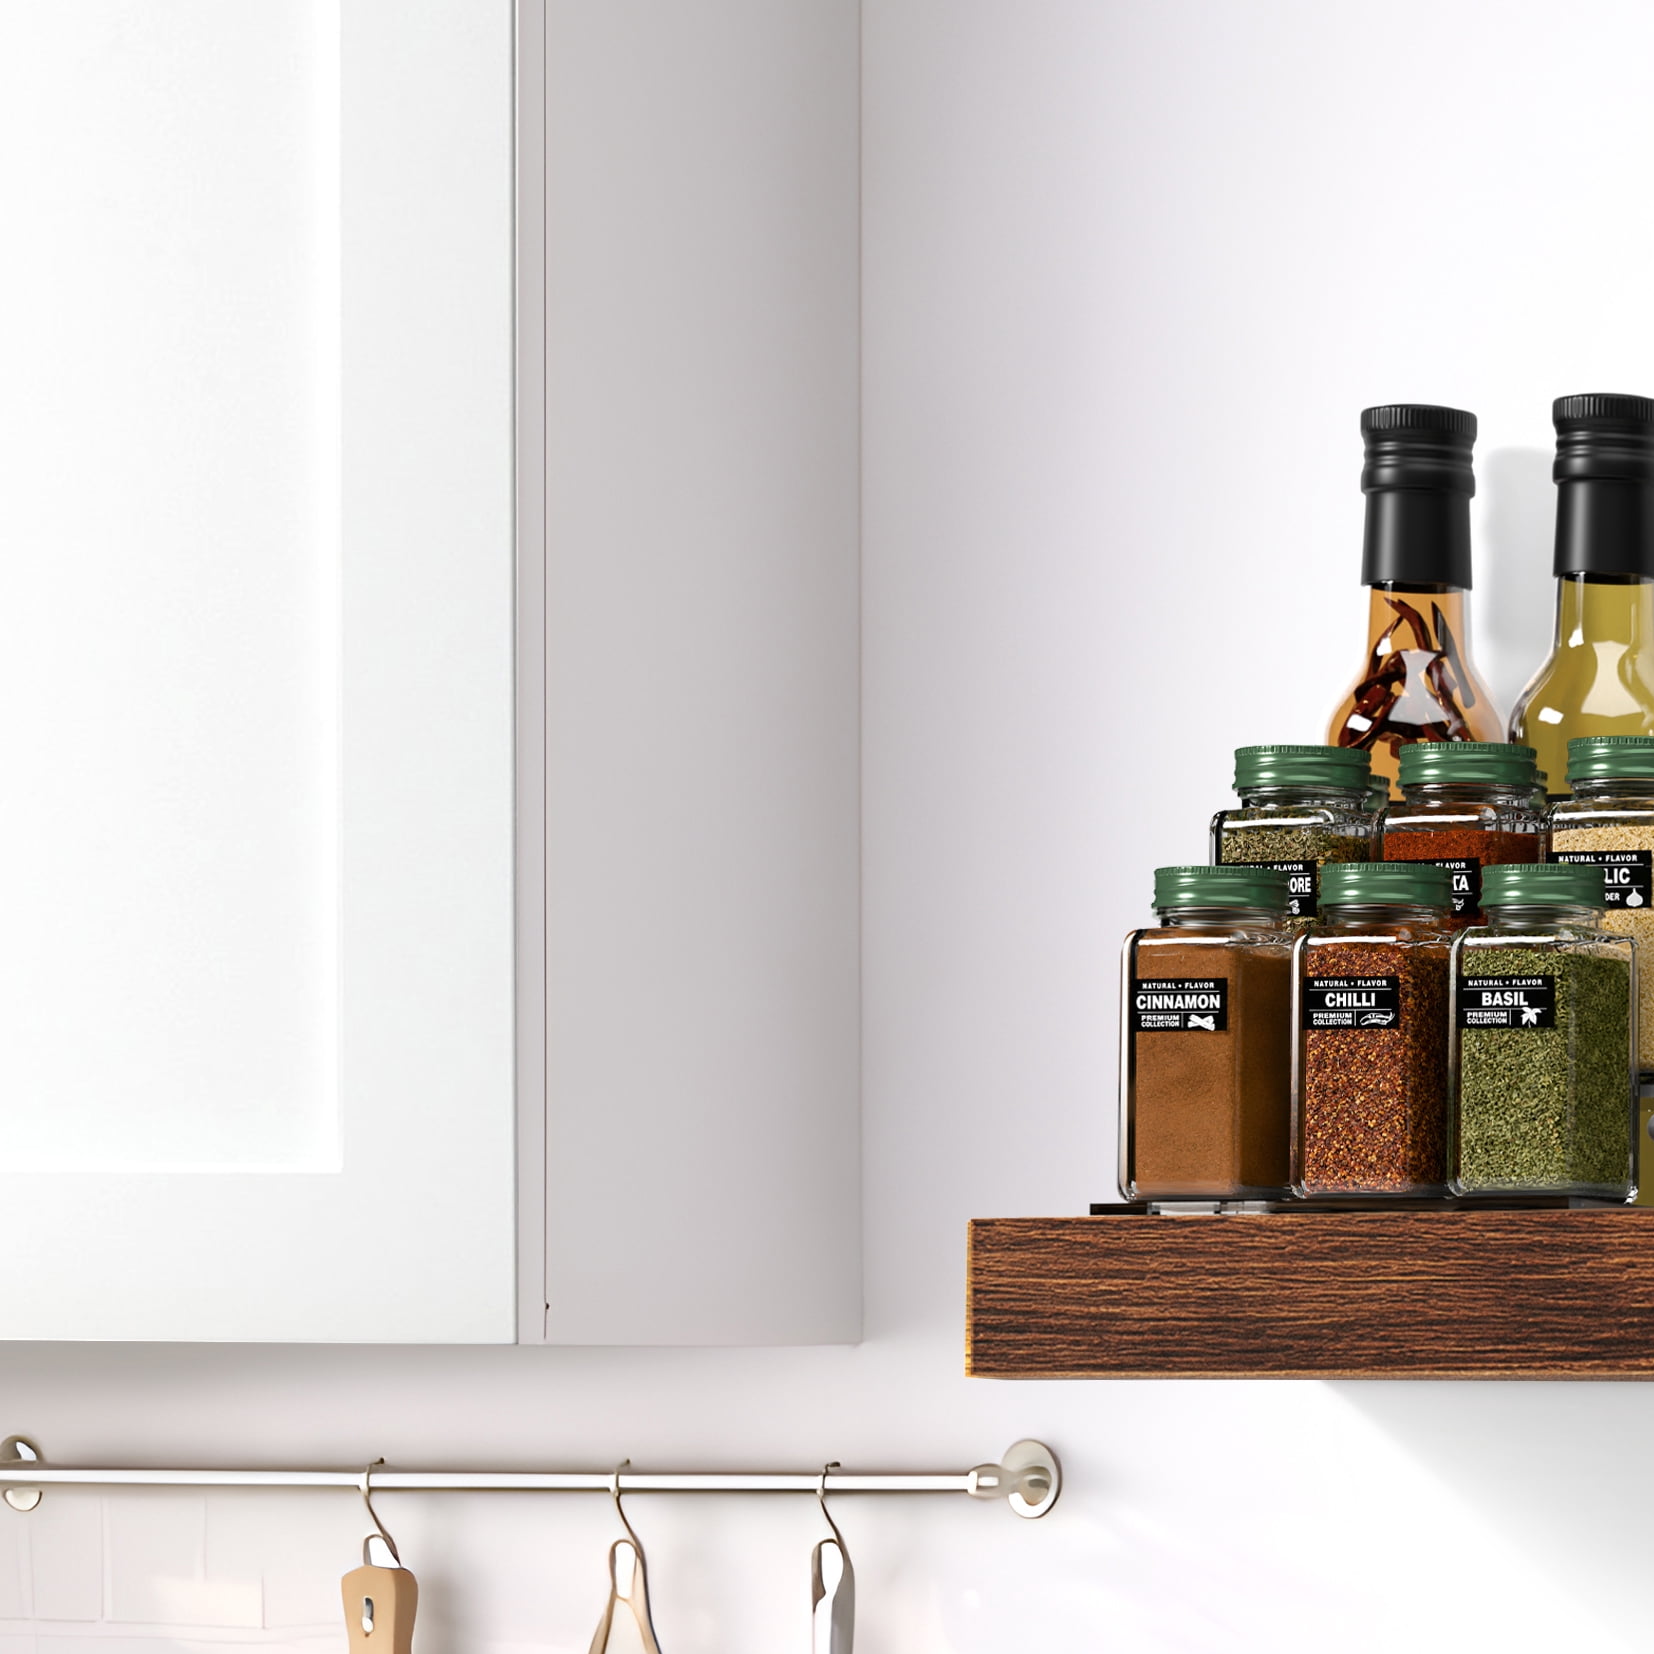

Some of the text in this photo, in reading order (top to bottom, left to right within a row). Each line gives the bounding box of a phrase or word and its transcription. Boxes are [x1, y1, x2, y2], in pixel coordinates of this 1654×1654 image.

[1558, 854, 1638, 863] NATURAL FLAVOR
[1273, 864, 1304, 872] FLAVOR
[1288, 876, 1312, 893] ORE
[1142, 981, 1215, 990] NATURAL FLAVOR
[1357, 979, 1387, 987] FLAVOR
[1468, 978, 1543, 987] NATURAL FLAVOR
[1135, 994, 1221, 1010] CINNAMON
[1324, 992, 1376, 1007] CHILLI
[1481, 991, 1529, 1006] BASIL
